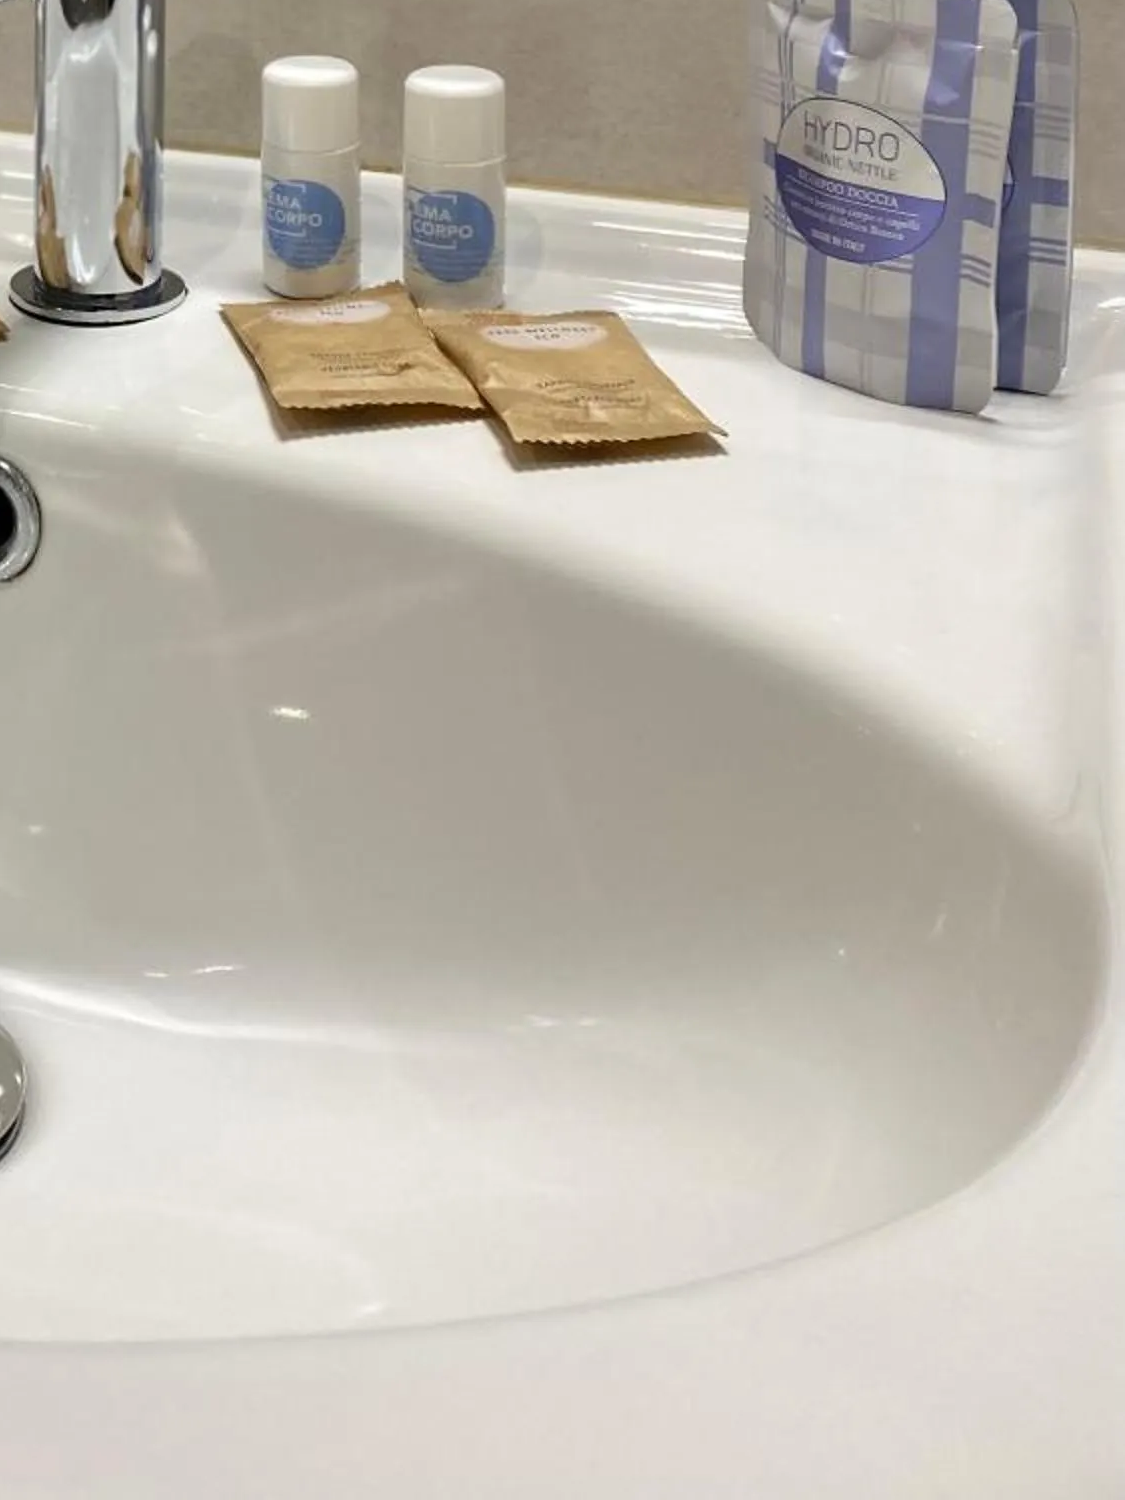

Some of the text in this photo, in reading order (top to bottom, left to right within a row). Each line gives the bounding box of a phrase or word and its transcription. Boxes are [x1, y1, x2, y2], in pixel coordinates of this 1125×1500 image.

[803, 110, 901, 162] HYDRO
[847, 186, 899, 210] DOCCIA
[267, 206, 323, 228] CORPO
[412, 218, 474, 240] CORPO
